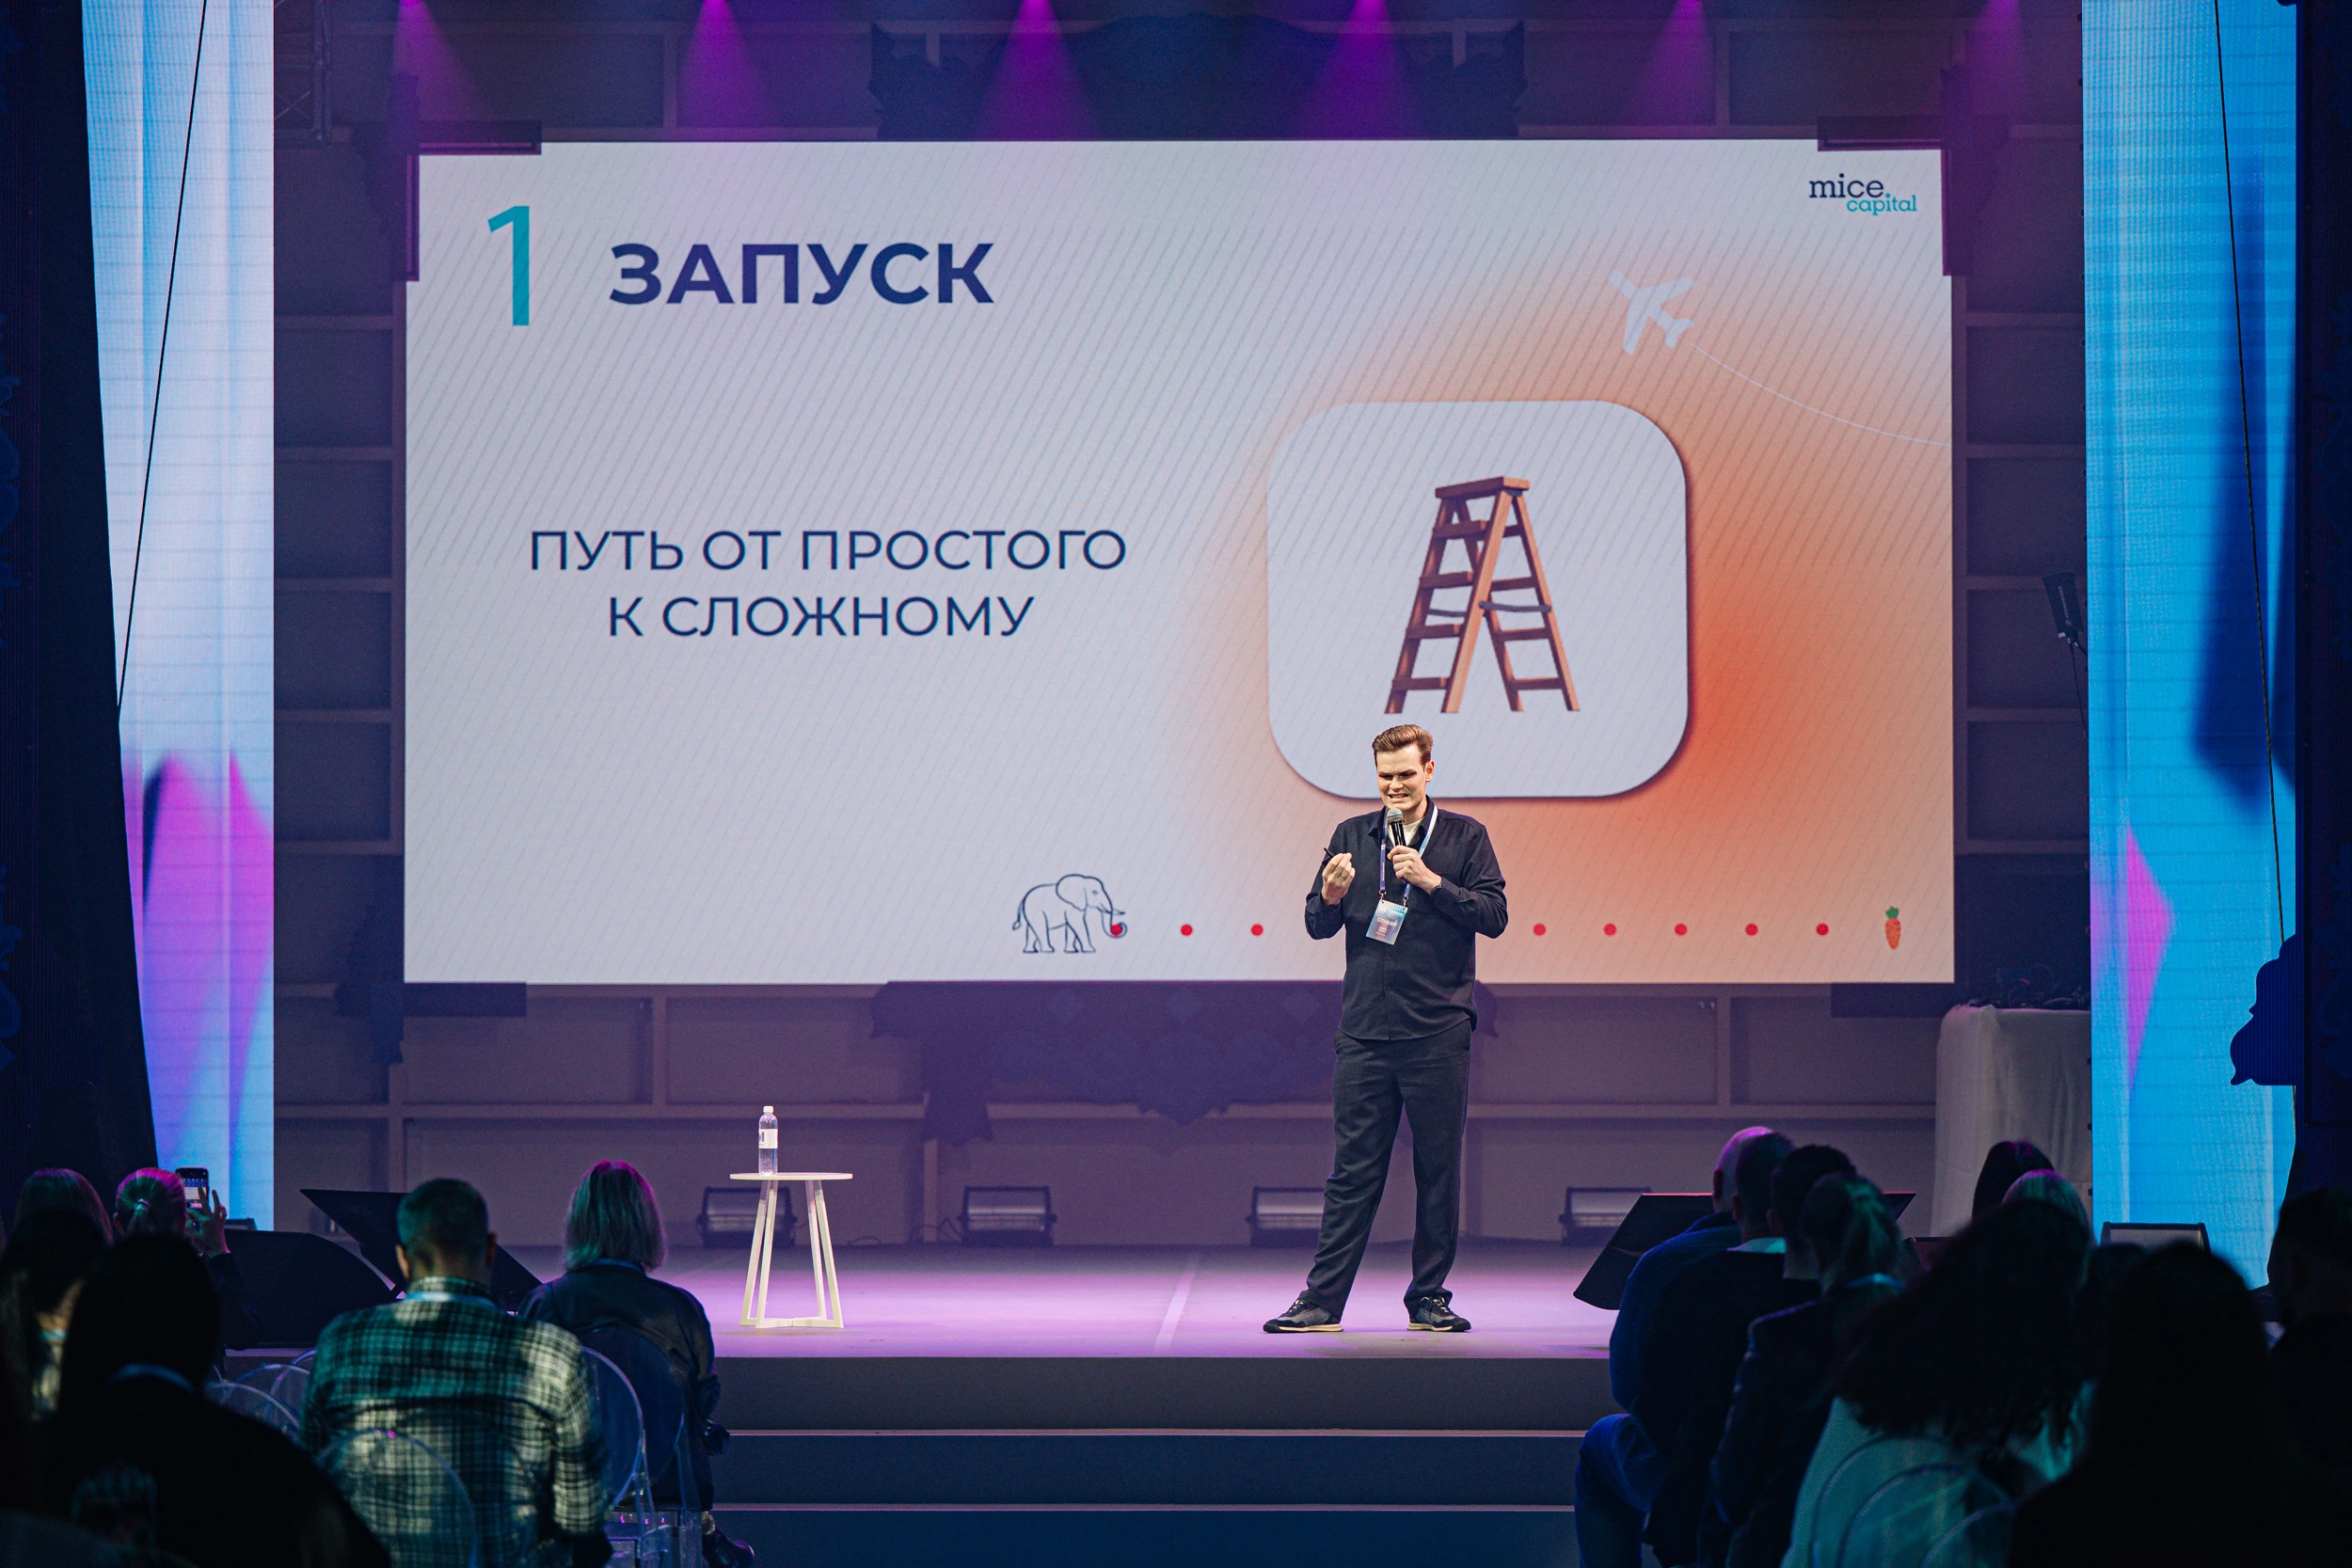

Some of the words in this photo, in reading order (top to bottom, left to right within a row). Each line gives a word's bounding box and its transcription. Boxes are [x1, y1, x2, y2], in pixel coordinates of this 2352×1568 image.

[1808, 172, 1884, 199] mice
[1846, 193, 1917, 215] capital
[486, 205, 531, 326] 1
[609, 242, 994, 306] ЗАПУСК
[531, 530, 685, 572] ПУТЬ
[703, 530, 783, 572] ОТ
[802, 530, 1127, 572] ПРОСТОГО
[610, 595, 644, 638] К
[662, 595, 1036, 638] СЛОЖНОМУ
